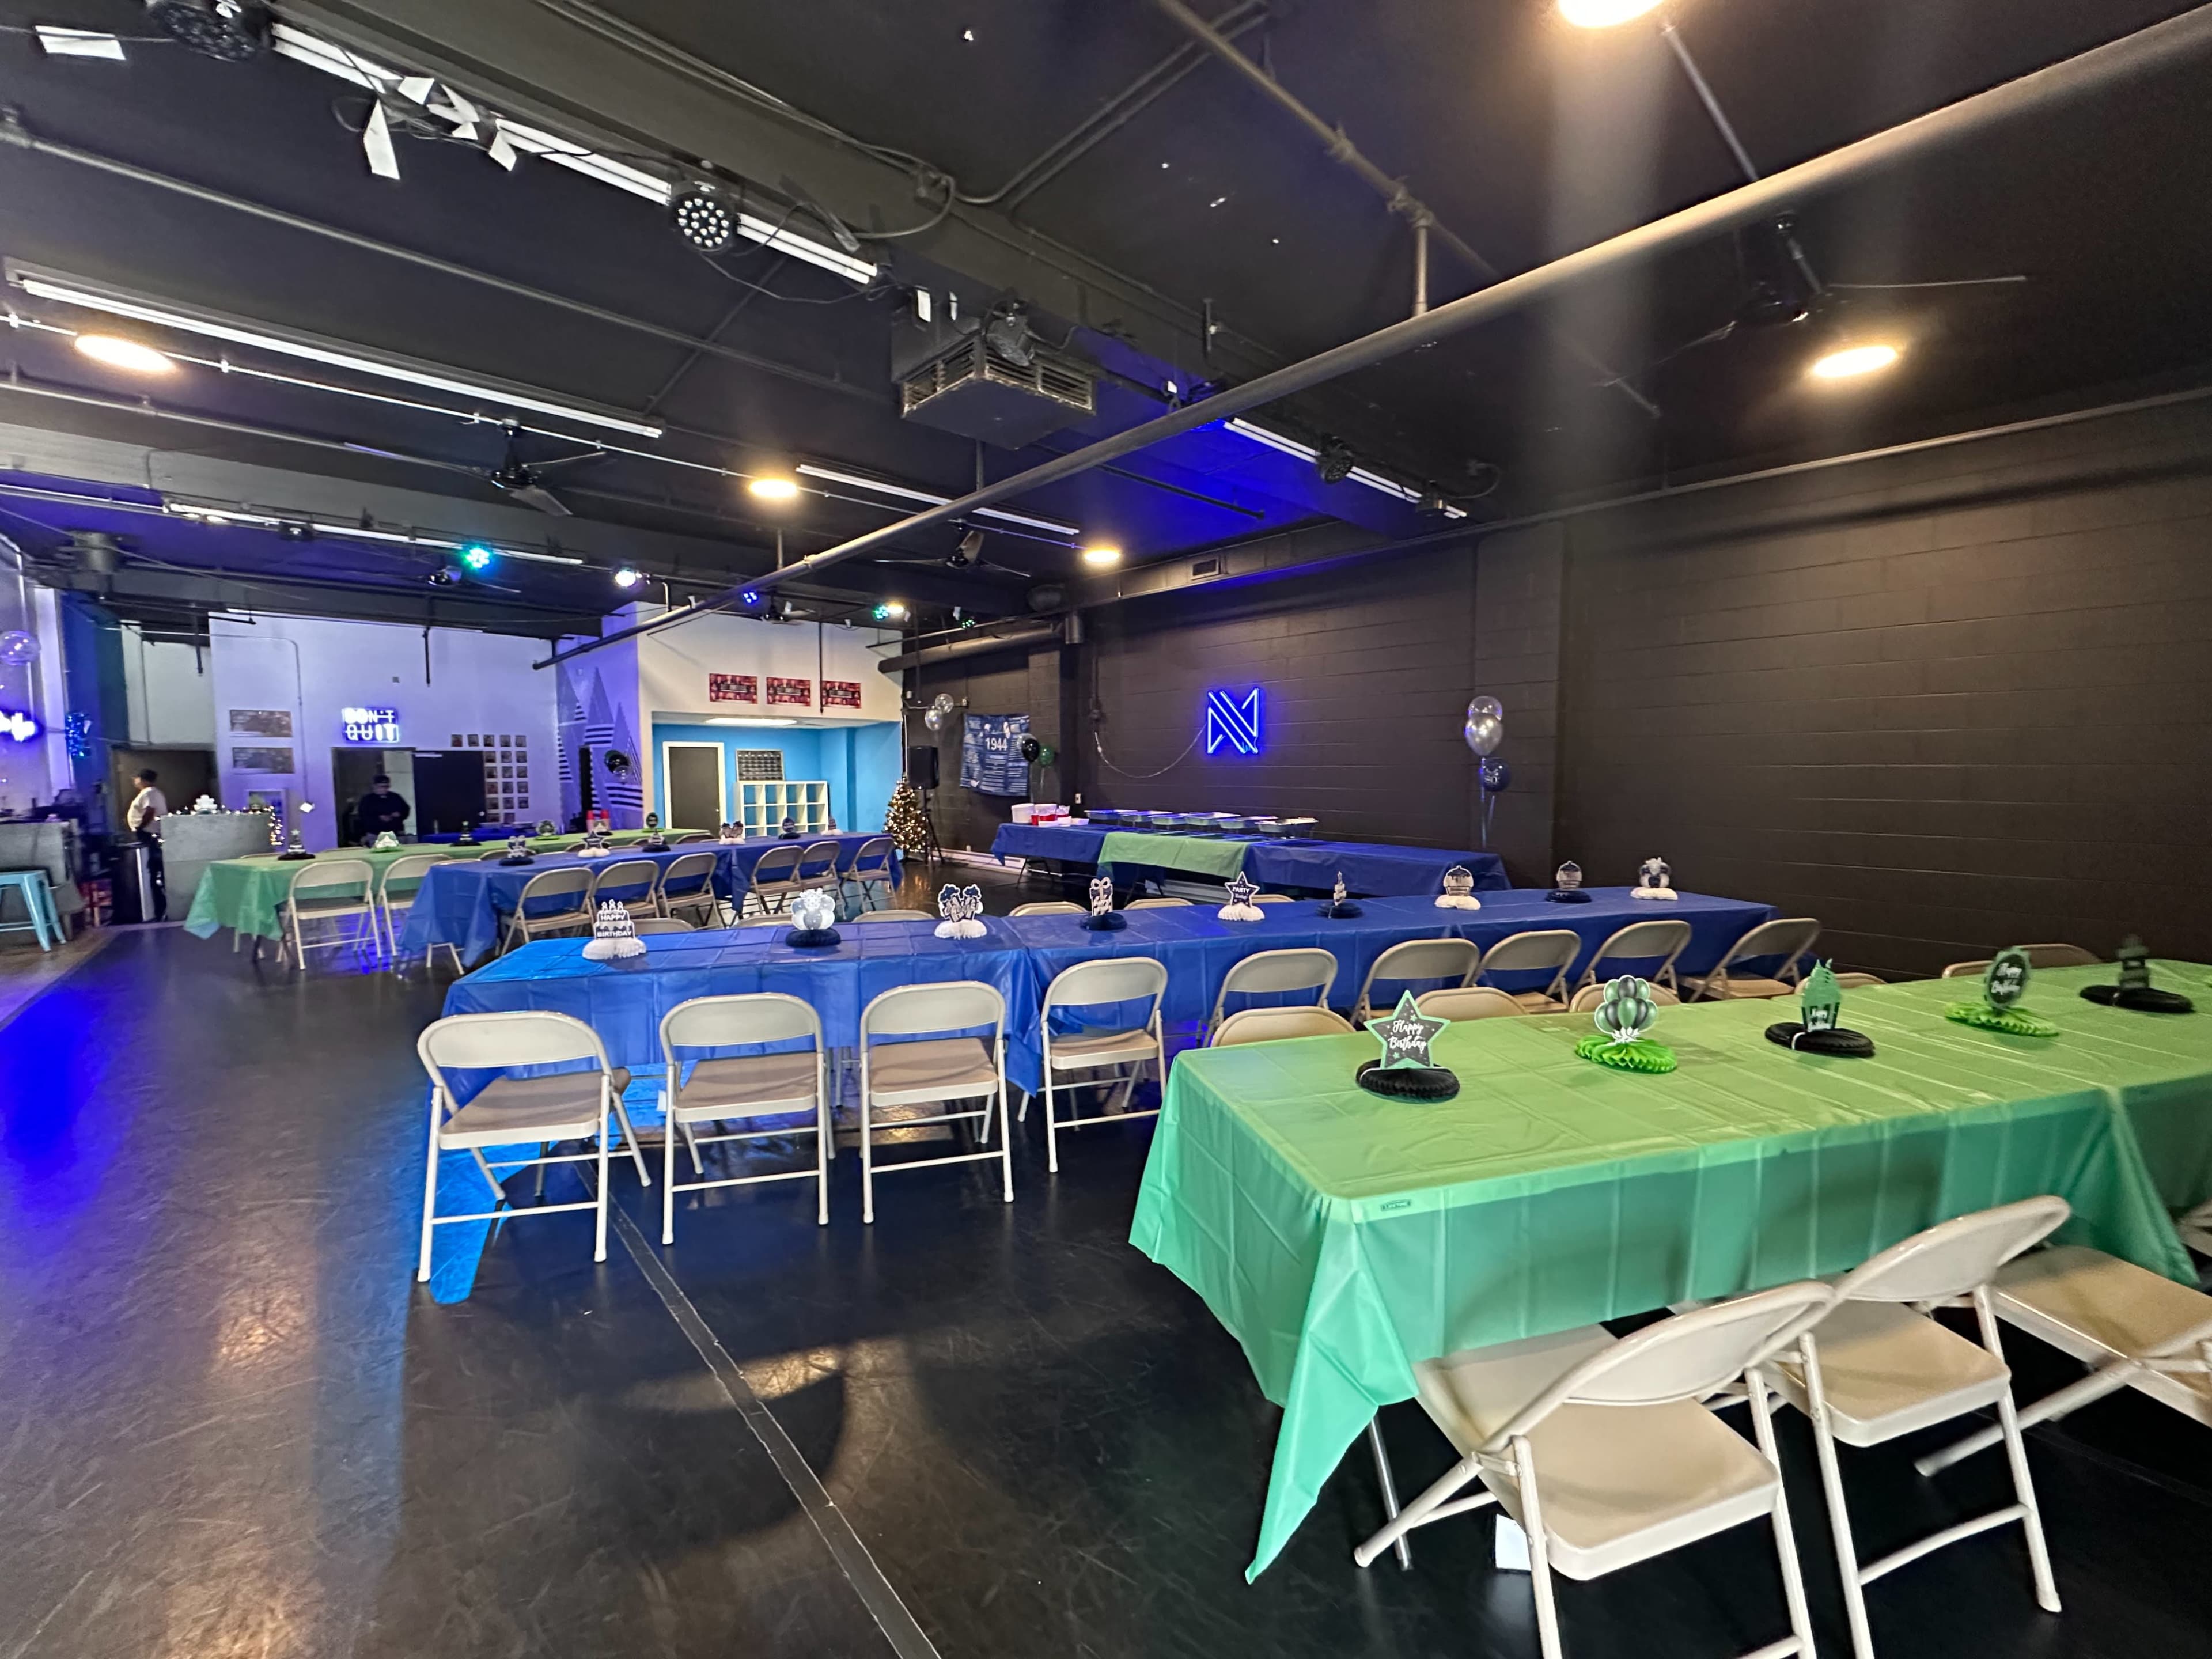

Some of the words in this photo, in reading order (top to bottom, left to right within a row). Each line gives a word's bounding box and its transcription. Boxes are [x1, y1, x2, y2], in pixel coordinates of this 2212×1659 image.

[346, 723, 397, 741] QUIT
[985, 737, 1007, 751] 1944
[1392, 1019, 1424, 1035] Happy
[1388, 1035, 1427, 1054] Birthday
